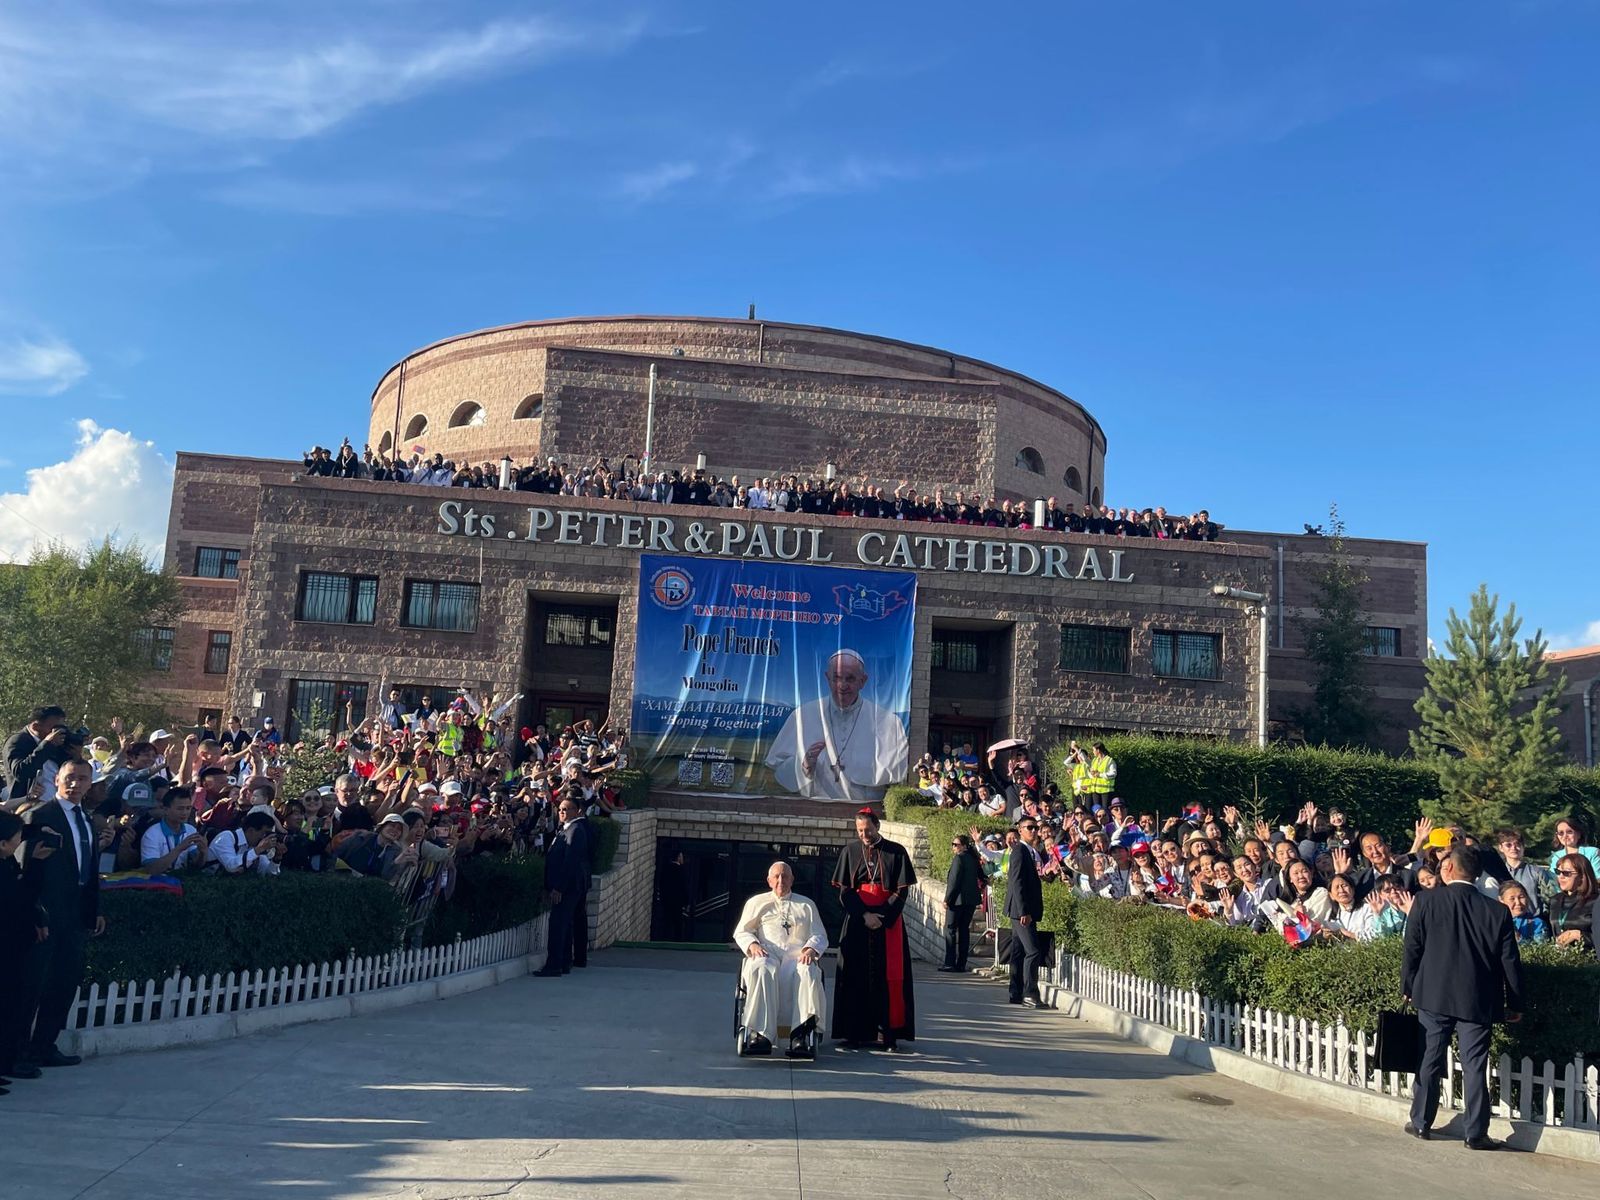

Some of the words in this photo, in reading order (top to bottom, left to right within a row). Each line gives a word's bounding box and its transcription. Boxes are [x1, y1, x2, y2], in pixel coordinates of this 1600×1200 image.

[857, 532, 1135, 583] CATHEDRAL
[731, 583, 811, 603] Welcome
[682, 624, 720, 660] Pope
[724, 626, 780, 656] Francis
[701, 662, 715, 676] In
[682, 676, 738, 692] Mongolia
